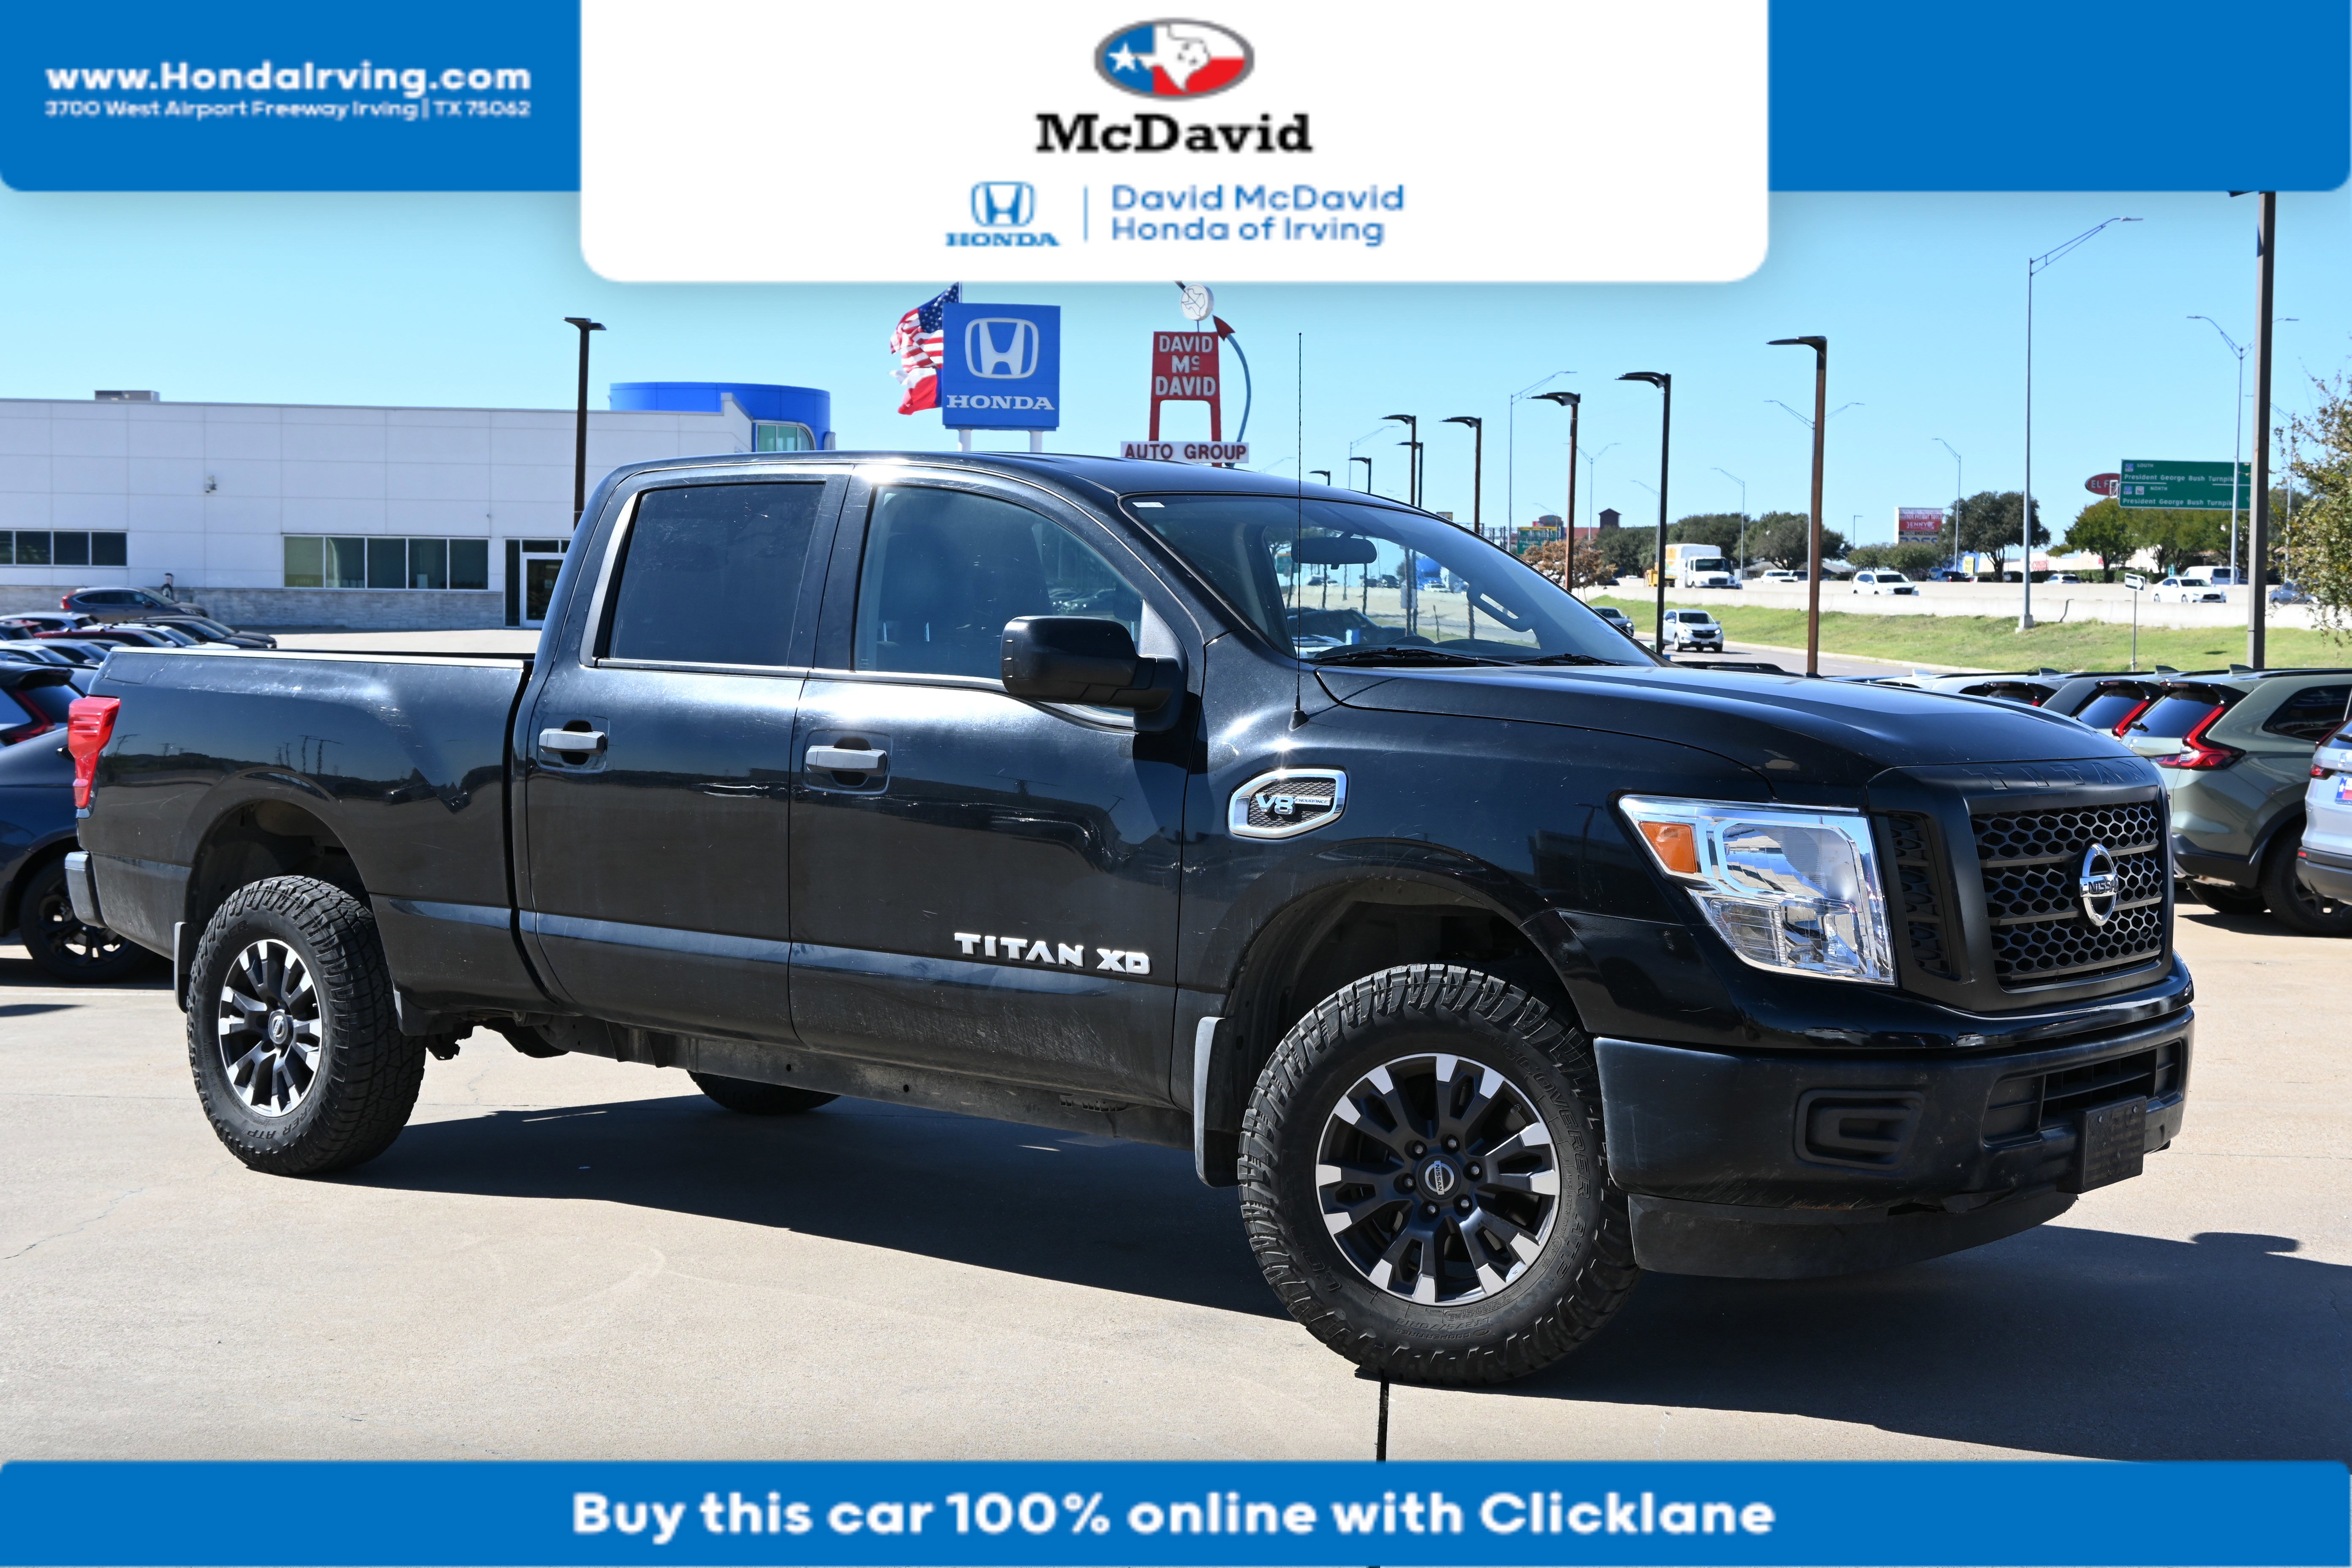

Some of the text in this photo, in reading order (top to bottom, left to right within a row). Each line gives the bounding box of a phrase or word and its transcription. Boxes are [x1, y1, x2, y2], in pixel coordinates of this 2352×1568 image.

[1159, 335, 1213, 353] DAVID
[1155, 376, 1216, 396] DAVID
[946, 395, 1055, 410] HONDA
[1124, 444, 1246, 460] AUTO GROUP
[1255, 794, 1296, 815] V8
[954, 932, 1150, 975] TITAN XD
[1396, 1317, 1490, 1330] LT275/70R18
